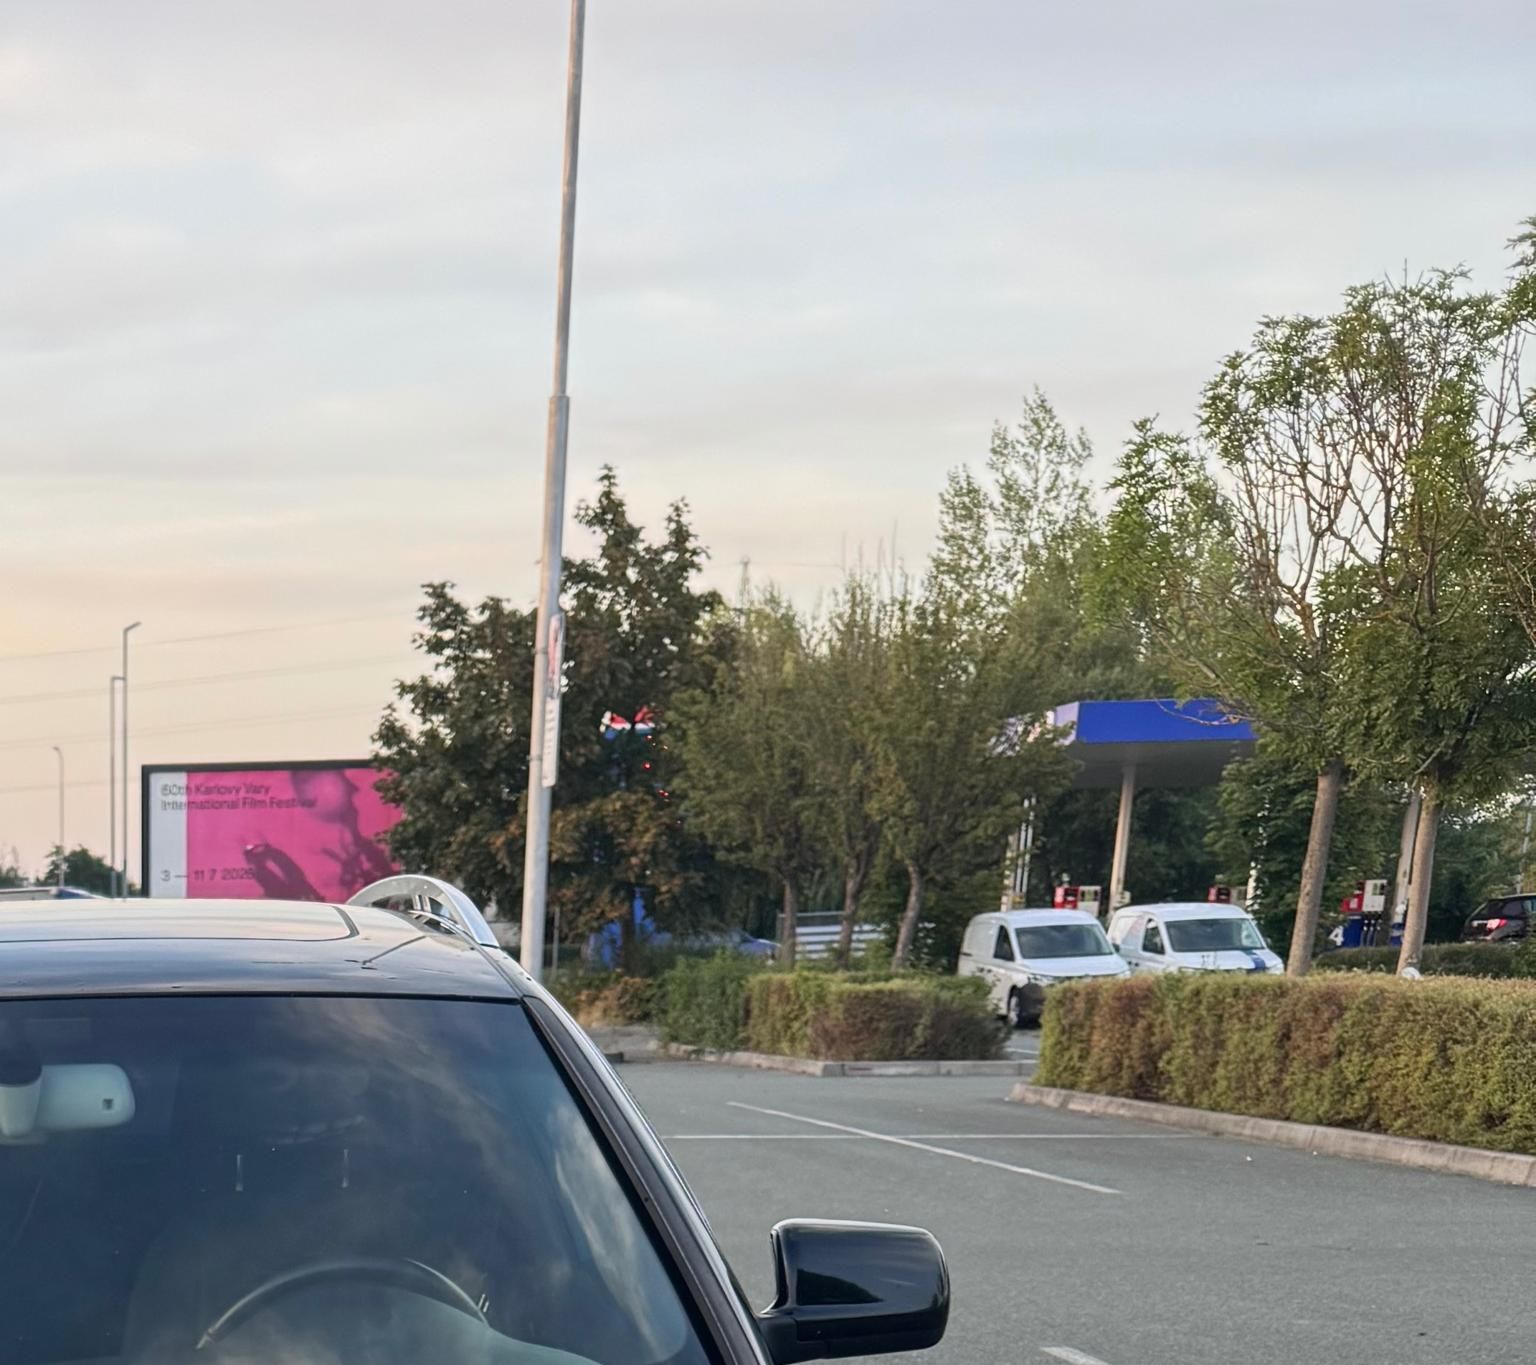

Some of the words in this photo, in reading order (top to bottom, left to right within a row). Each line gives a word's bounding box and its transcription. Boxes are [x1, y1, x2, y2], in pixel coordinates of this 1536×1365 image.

[195, 783, 241, 797] Karlovy
[242, 782, 272, 797] Vary
[161, 799, 241, 811] International
[242, 798, 267, 810] Film
[269, 797, 317, 809] Festival
[1328, 925, 1344, 946] 4
